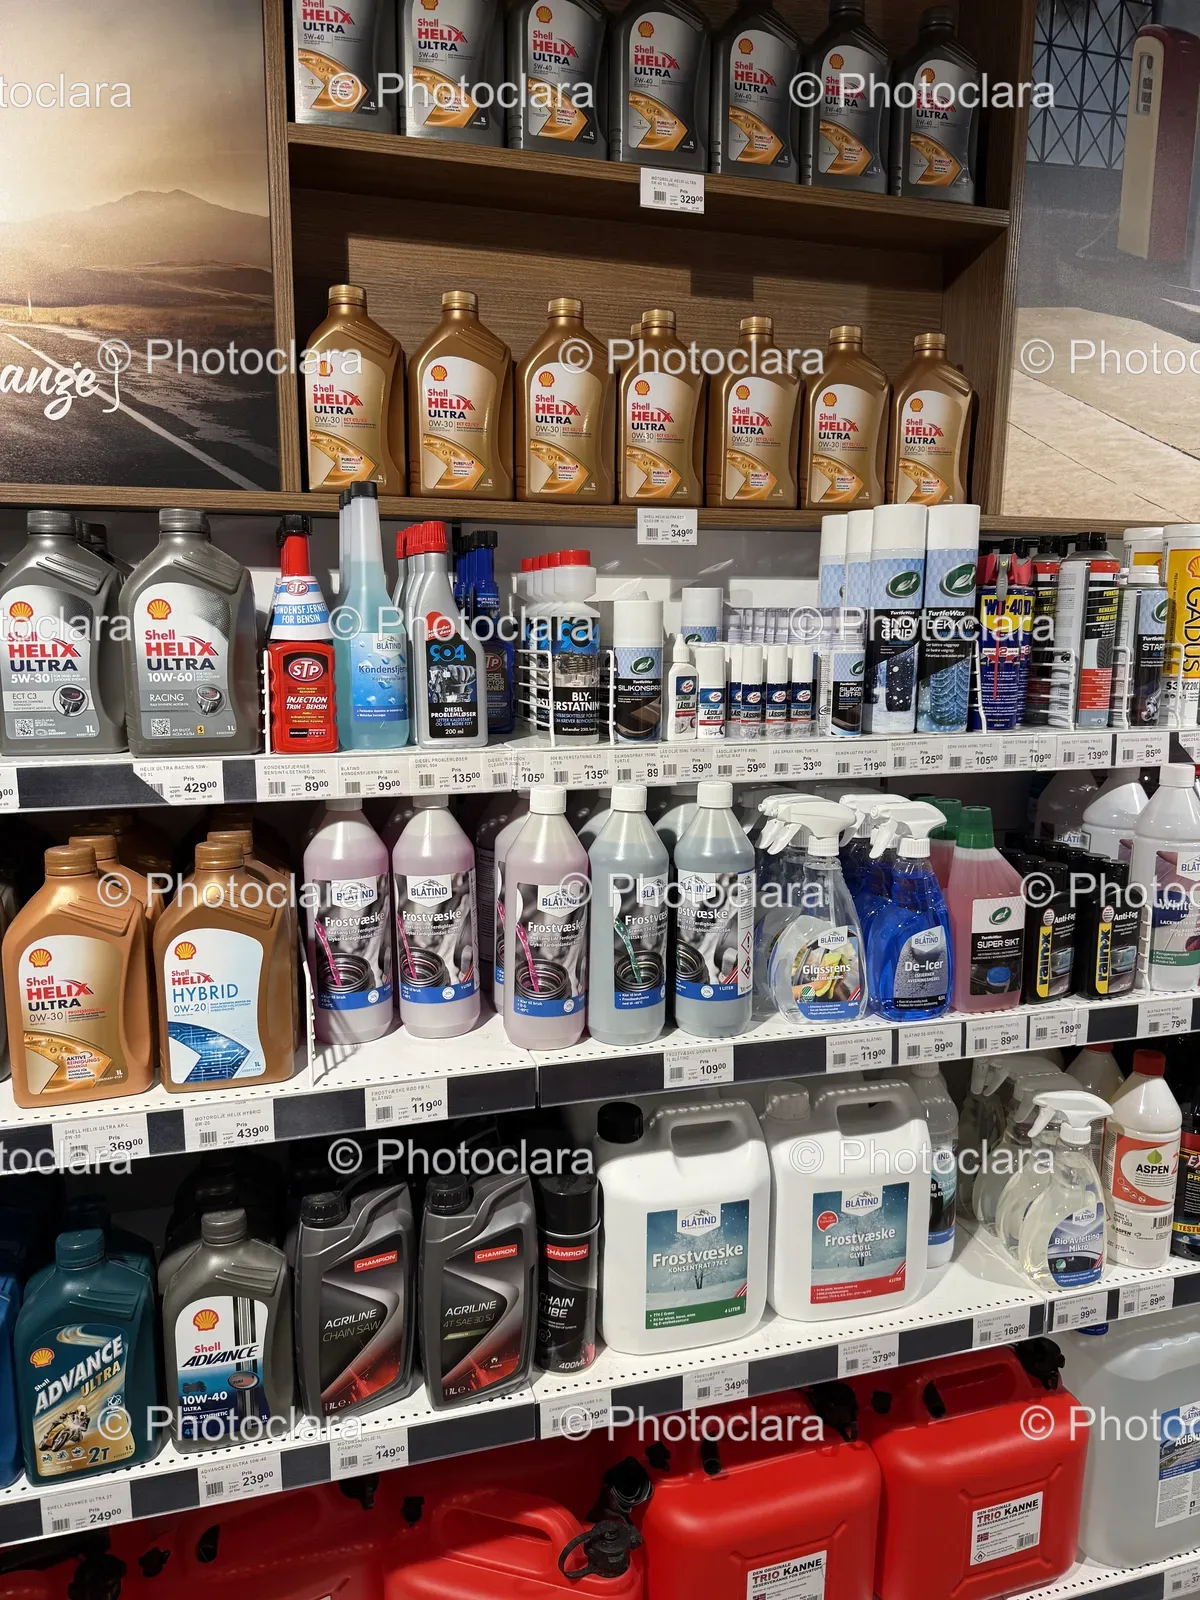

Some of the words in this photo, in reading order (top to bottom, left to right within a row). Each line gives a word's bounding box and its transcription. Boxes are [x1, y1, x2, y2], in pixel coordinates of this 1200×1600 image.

[418, 18, 439, 28] Shell
[418, 28, 467, 43] HELIX
[418, 41, 458, 51] ULTRA
[634, 45, 654, 54] Shell
[634, 54, 680, 70] HELIX
[734, 61, 753, 71] Shell
[634, 66, 671, 78] ULTRA
[734, 70, 777, 86] HELIX
[734, 82, 768, 94] ULTRA
[734, 92, 752, 100] 5W-40
[313, 384, 334, 393] Shell
[428, 388, 448, 397] Shell
[313, 394, 364, 406] HELIX
[428, 398, 476, 410] HELIX
[632, 402, 650, 410] Shell
[314, 406, 354, 415] ULTRA
[428, 410, 466, 419] ULTRA
[732, 406, 750, 415] Shell
[314, 416, 340, 424] 0W-30
[632, 411, 674, 423] HELIX
[732, 415, 772, 427] HELIX
[428, 420, 453, 428] 0W-30
[632, 422, 666, 431] ULTRA
[632, 432, 654, 440] 0W-30
[732, 426, 764, 435] ULTRA
[288, 580, 307, 593] STP
[282, 615, 295, 624] FOR
[296, 614, 321, 623] BENSIN
[145, 630, 175, 641] Shell
[8, 643, 81, 658] HELIX
[146, 642, 218, 656] HELIX
[376, 641, 401, 650] BLÅTIND
[430, 644, 466, 662] 904
[10, 660, 78, 672] ULTRA
[147, 658, 216, 670] ULTRA
[292, 660, 319, 678] STP
[11, 674, 50, 683] 5W-30
[148, 672, 192, 682] 10W-60
[150, 694, 184, 702] RACING
[86, 725, 95, 733] 1L
[410, 887, 448, 896] BLÅTIND
[325, 912, 384, 927] Frostvæske
[403, 910, 462, 921] Frostvæske
[1114, 911, 1138, 921] Anti-Fog
[820, 935, 844, 944] BLÅTIND
[915, 935, 938, 944] BLÅTIND
[977, 940, 1003, 949] SUPER
[1004, 938, 1019, 947] SIKT
[802, 964, 850, 975] Glassrens
[904, 959, 943, 972] De-Icer
[171, 969, 189, 977] Shell
[26, 976, 54, 986] Shell
[171, 973, 214, 986] HELIX
[26, 983, 94, 1000] HELIX
[173, 984, 238, 1002] HYBRID
[28, 999, 81, 1012] ULTRA
[174, 1003, 206, 1014] 0W-20
[30, 1012, 63, 1022] 0W-30
[1136, 1164, 1169, 1174] ASPEN
[846, 1196, 878, 1208] BLÅTIND
[681, 1216, 717, 1228] BLÅTIND
[1074, 1212, 1095, 1222] BLÅTIND
[825, 1227, 895, 1247] Frostvæske
[1054, 1236, 1067, 1245] Bio
[1068, 1233, 1099, 1245] Avfetting
[476, 1247, 516, 1260] CHAMPION
[1068, 1243, 1089, 1252] Mikro
[652, 1244, 744, 1268] Frostvæske
[850, 1250, 871, 1258] GLYKOL
[356, 1254, 396, 1269] CHAMPION
[668, 1262, 711, 1273] KONSENTRAT
[445, 1301, 496, 1317] AGRILINE
[324, 1308, 377, 1330] AGRILINE
[322, 1326, 355, 1342] CHAIN
[357, 1319, 381, 1335] SAW
[194, 1342, 221, 1354] Shell
[182, 1345, 259, 1368] ADVANCE
[35, 1334, 123, 1416] ADVANCE
[81, 1364, 121, 1398] ULTRA
[34, 1378, 50, 1392] Shell
[182, 1391, 228, 1405] 10W-40
[88, 1446, 110, 1465] 2T
[977, 1511, 1001, 1523] TRIO
[1005, 1499, 1038, 1515] KANNE
[752, 1571, 780, 1584] TRIO
[783, 1558, 822, 1576] KANNE
